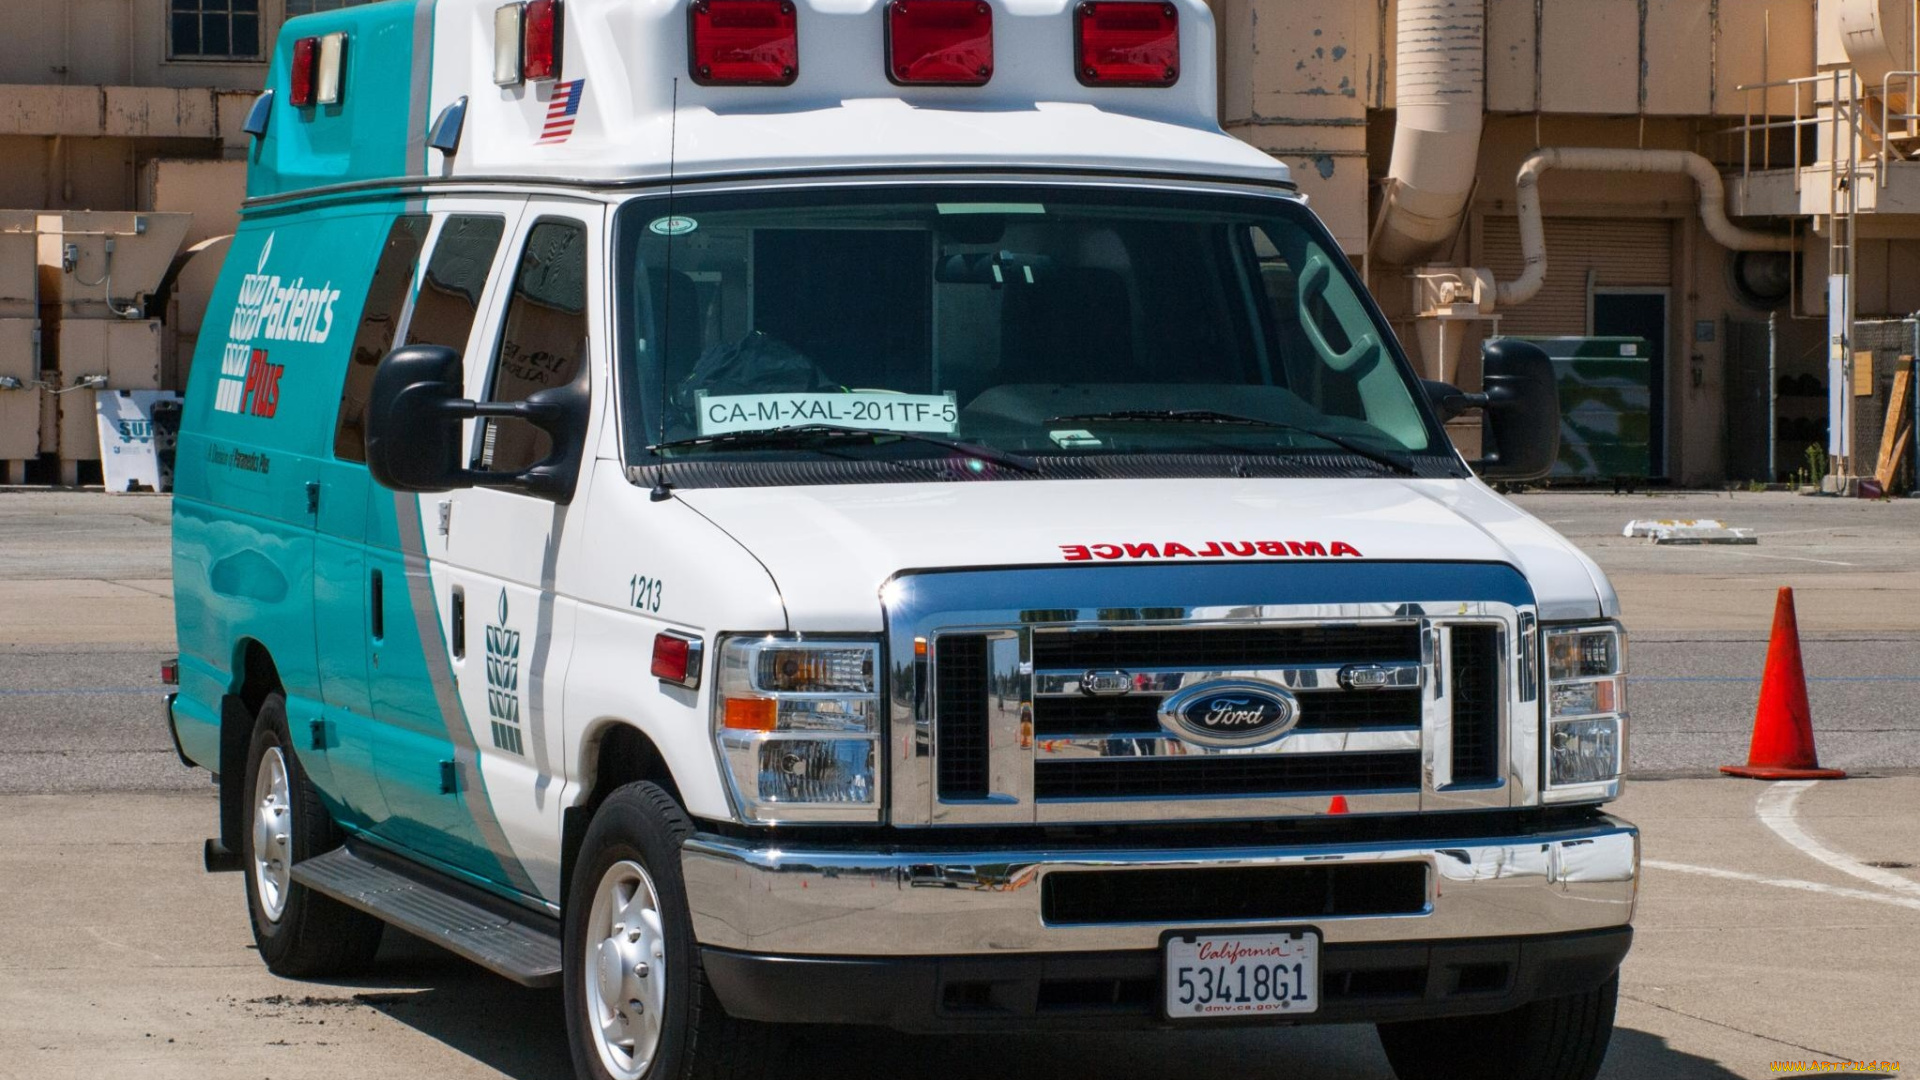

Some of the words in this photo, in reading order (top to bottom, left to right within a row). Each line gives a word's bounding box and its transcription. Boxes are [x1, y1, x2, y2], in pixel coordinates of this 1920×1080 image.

[253, 275, 341, 344] Patients
[240, 348, 285, 419] Plus
[708, 399, 957, 424] CA-M-XAL-201TF-5
[630, 573, 662, 613] 1213
[1205, 698, 1265, 725] Ford
[1199, 941, 1290, 964] California
[1178, 963, 1308, 1004] 53418G1
[1205, 1003, 1281, 1013] dmv.ca.gov
